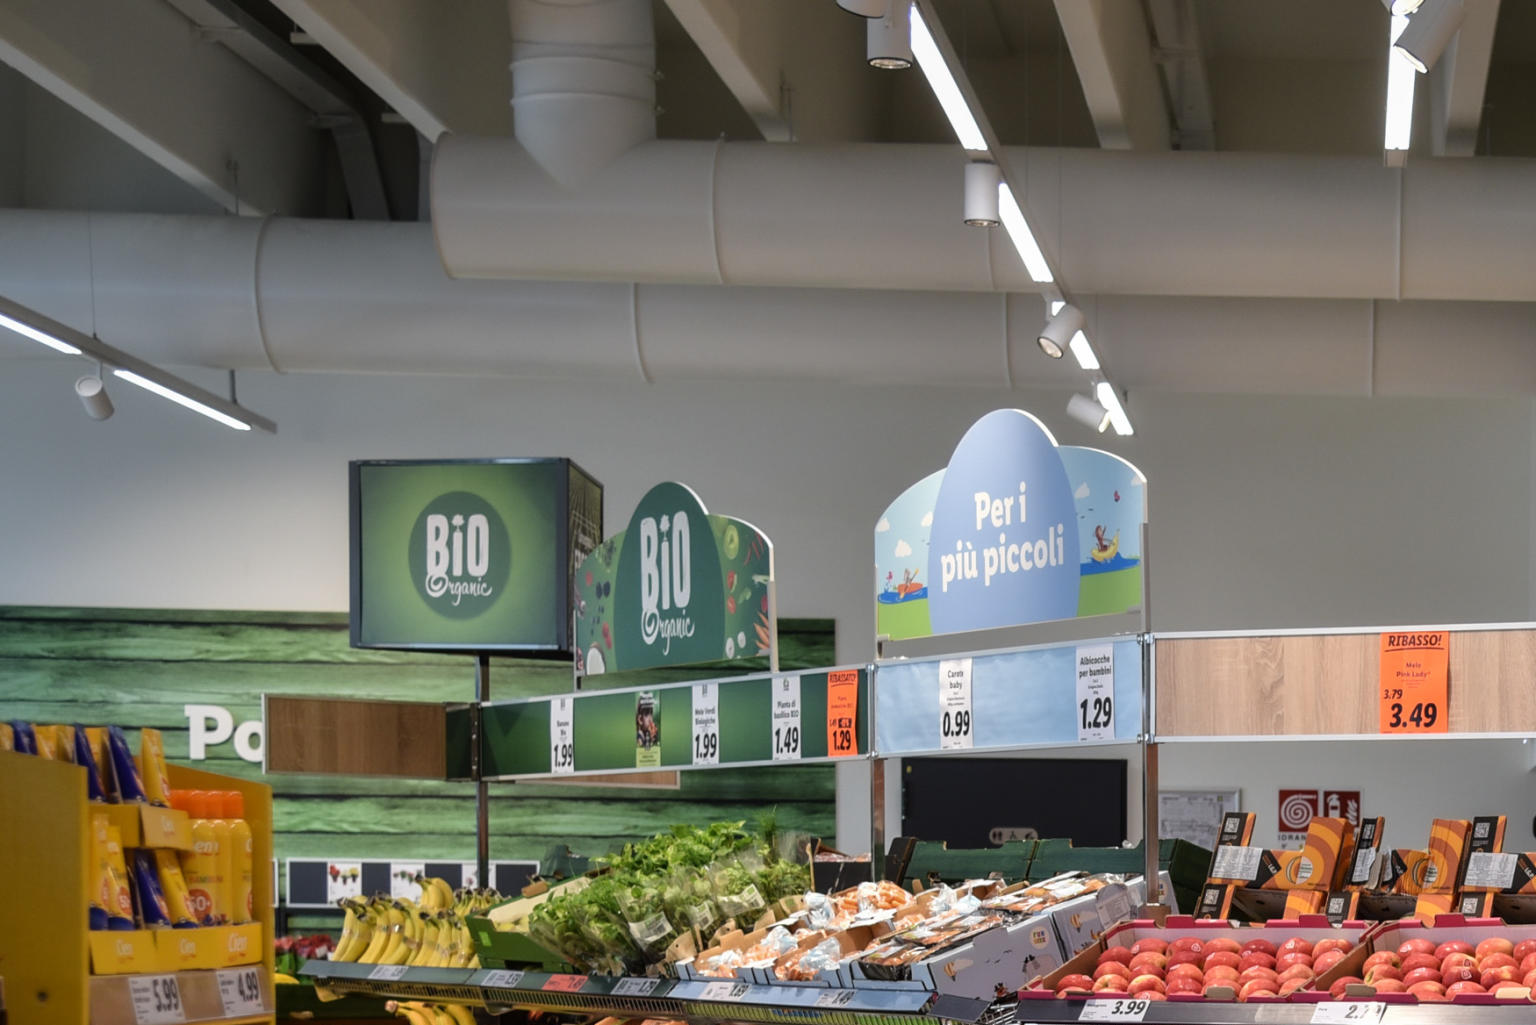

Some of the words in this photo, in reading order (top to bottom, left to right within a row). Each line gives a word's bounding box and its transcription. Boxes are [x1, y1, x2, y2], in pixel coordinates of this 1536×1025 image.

[974, 491, 1015, 530] Per
[1019, 481, 1026, 522] i
[941, 540, 978, 592] più
[984, 523, 1064, 586] piccoli
[425, 571, 493, 606] Organic
[640, 608, 695, 655] Organic
[1388, 635, 1442, 646] RIBASSO!
[1079, 667, 1088, 678] per
[1089, 665, 1112, 677] bambini
[1080, 655, 1111, 665] Albicocche
[949, 679, 963, 690] baby
[1384, 689, 1403, 699] 3.79
[942, 710, 970, 737] 0.99
[1080, 697, 1112, 730] 1.29
[1389, 703, 1437, 727] 3.49
[695, 733, 717, 759] 1.99
[775, 727, 799, 755] 1.49
[833, 730, 851, 751] 1.29
[554, 743, 573, 768] 1.99
[152, 977, 179, 1012] 5.99
[238, 971, 259, 1002] 4.99
[1112, 1001, 1146, 1015] 3.99
